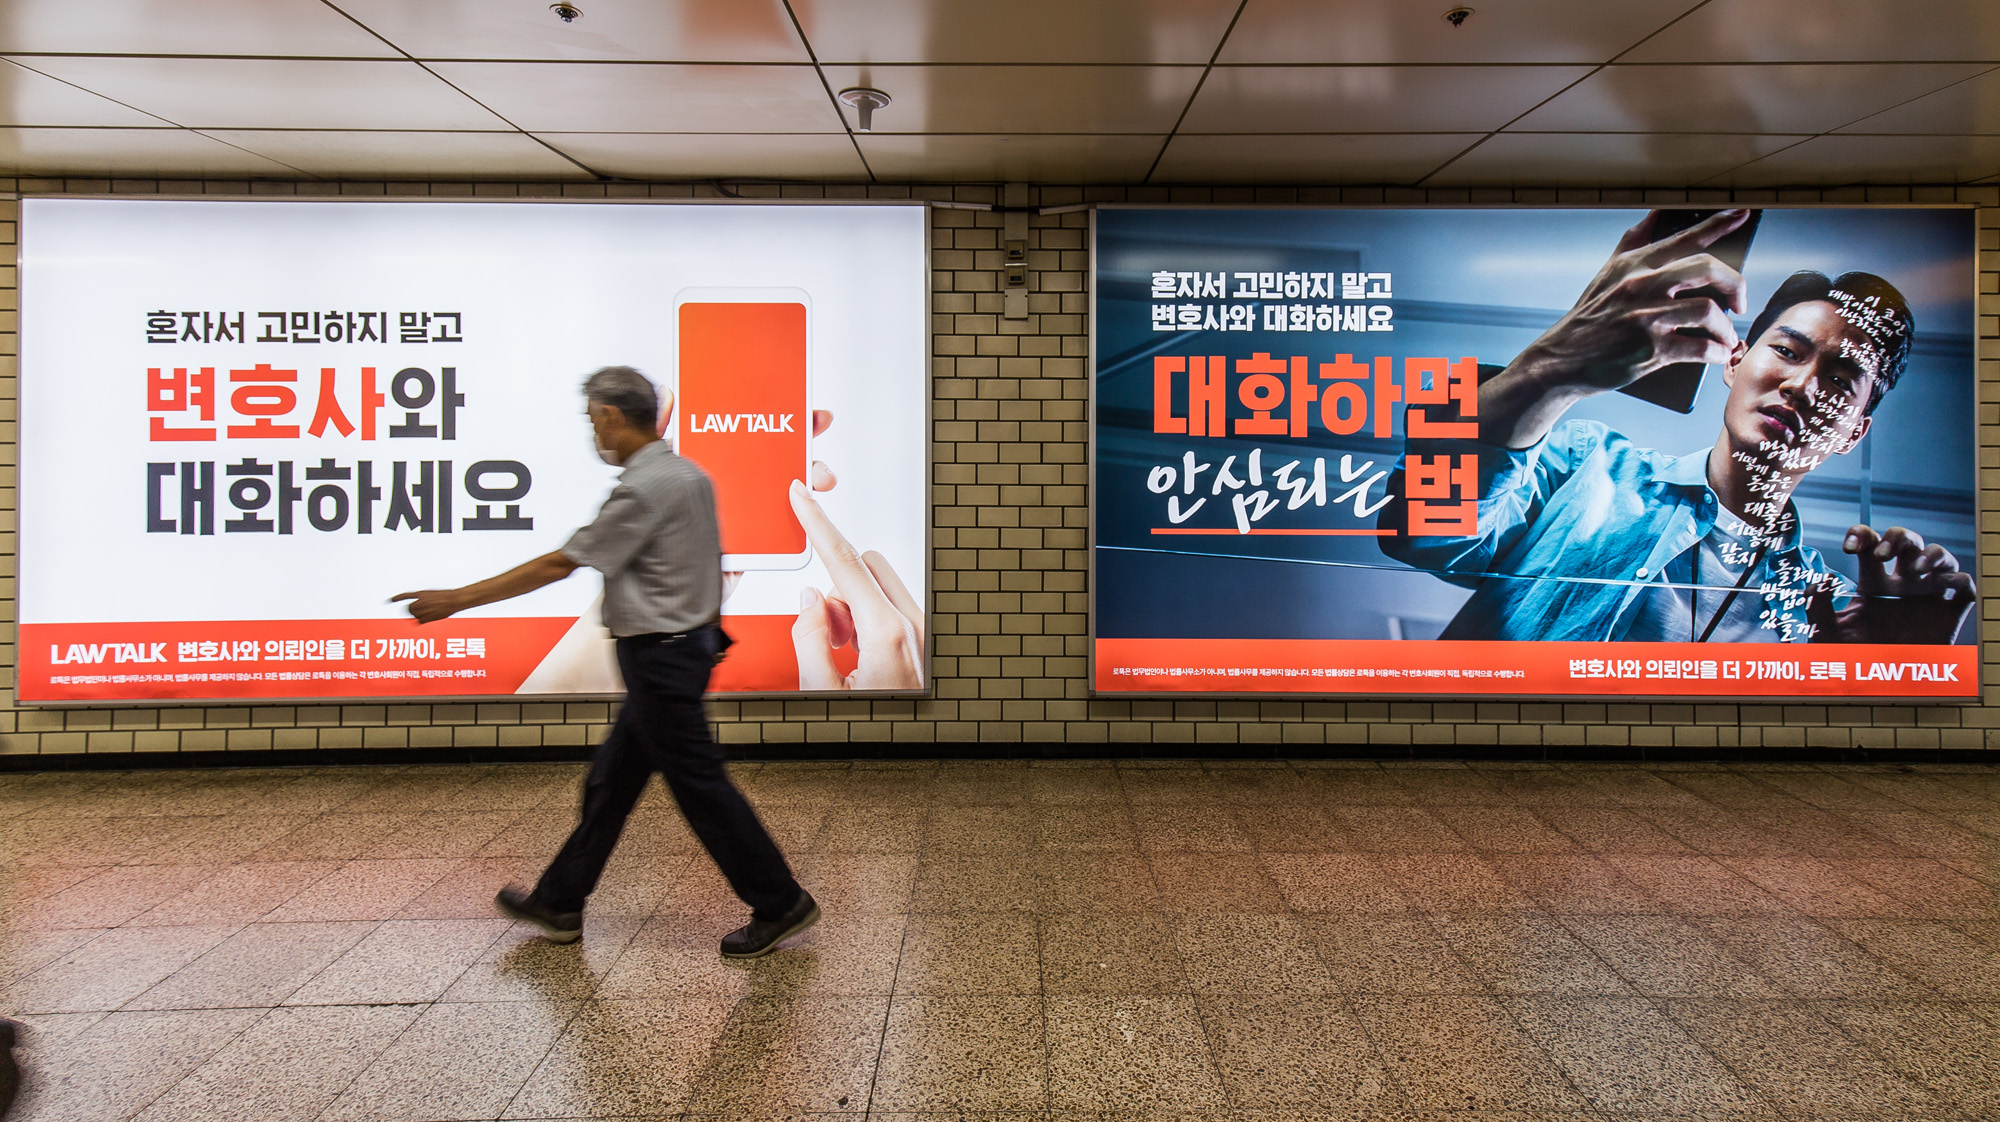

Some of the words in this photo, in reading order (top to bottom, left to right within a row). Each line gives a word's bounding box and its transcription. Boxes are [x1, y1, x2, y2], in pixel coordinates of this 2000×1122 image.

[1151, 271, 1226, 299] 혼자서
[1232, 271, 1334, 299] 고민하지
[1341, 272, 1393, 299] 말고
[145, 309, 245, 343] 혼자서
[256, 310, 388, 343] 고민하지
[399, 312, 463, 343] 말고
[1152, 304, 1256, 331] 변호사와
[1263, 304, 1394, 332] 대화하세요
[1864, 295, 1881, 308] 이
[1881, 308, 1906, 336] 코인
[146, 363, 465, 442] 변호사와
[1153, 352, 1479, 439] 대화하면
[1814, 389, 1828, 399] 나
[1828, 393, 1861, 419] 사기
[690, 413, 795, 433] LAWTALK
[1809, 415, 1825, 426] 왜
[1731, 451, 1770, 475] 어떻게
[1767, 470, 1793, 489] 모은
[1759, 440, 1823, 471] 망했다
[146, 457, 534, 536] 대화하세요
[1146, 447, 1396, 535] 안심되는
[1405, 454, 1479, 536] 법
[1746, 474, 1791, 505] 돈인데
[1743, 502, 1796, 535] 대출은
[1727, 521, 1784, 552] 어떻게
[1718, 542, 1757, 567] 갚지
[1775, 558, 1848, 597] 돌려받는
[1759, 582, 1814, 611] 방법이
[1759, 609, 1820, 642] 있을까
[50, 642, 168, 665] LAWTALK
[178, 641, 260, 663] 변호사와
[264, 640, 346, 662] 의뢰인을
[350, 639, 370, 661] 더
[375, 638, 441, 660] 가까이,
[445, 637, 487, 660] 로톡
[332, 671, 358, 680] 이용하는
[359, 671, 366, 679] 각
[1112, 667, 1132, 676] 로톡은
[1132, 667, 1169, 676] 법무법인이나
[1169, 667, 1207, 676] 법률사무소가
[1227, 668, 1258, 677] 법률사무를
[1259, 668, 1284, 677] 제공하지
[1311, 668, 1324, 677] 모든
[1324, 668, 1356, 677] 법률상담은
[1356, 669, 1375, 677] 로톡을
[1376, 669, 1400, 678] 이용하는
[1401, 669, 1408, 677] 각
[1569, 659, 1642, 680] 변호사와
[1645, 660, 1718, 680] 의뢰인을
[1722, 660, 1740, 680] 더
[1745, 660, 1806, 682] 가까이,
[1809, 661, 1847, 681] 로톡
[1855, 662, 1959, 682] LAWTALK
